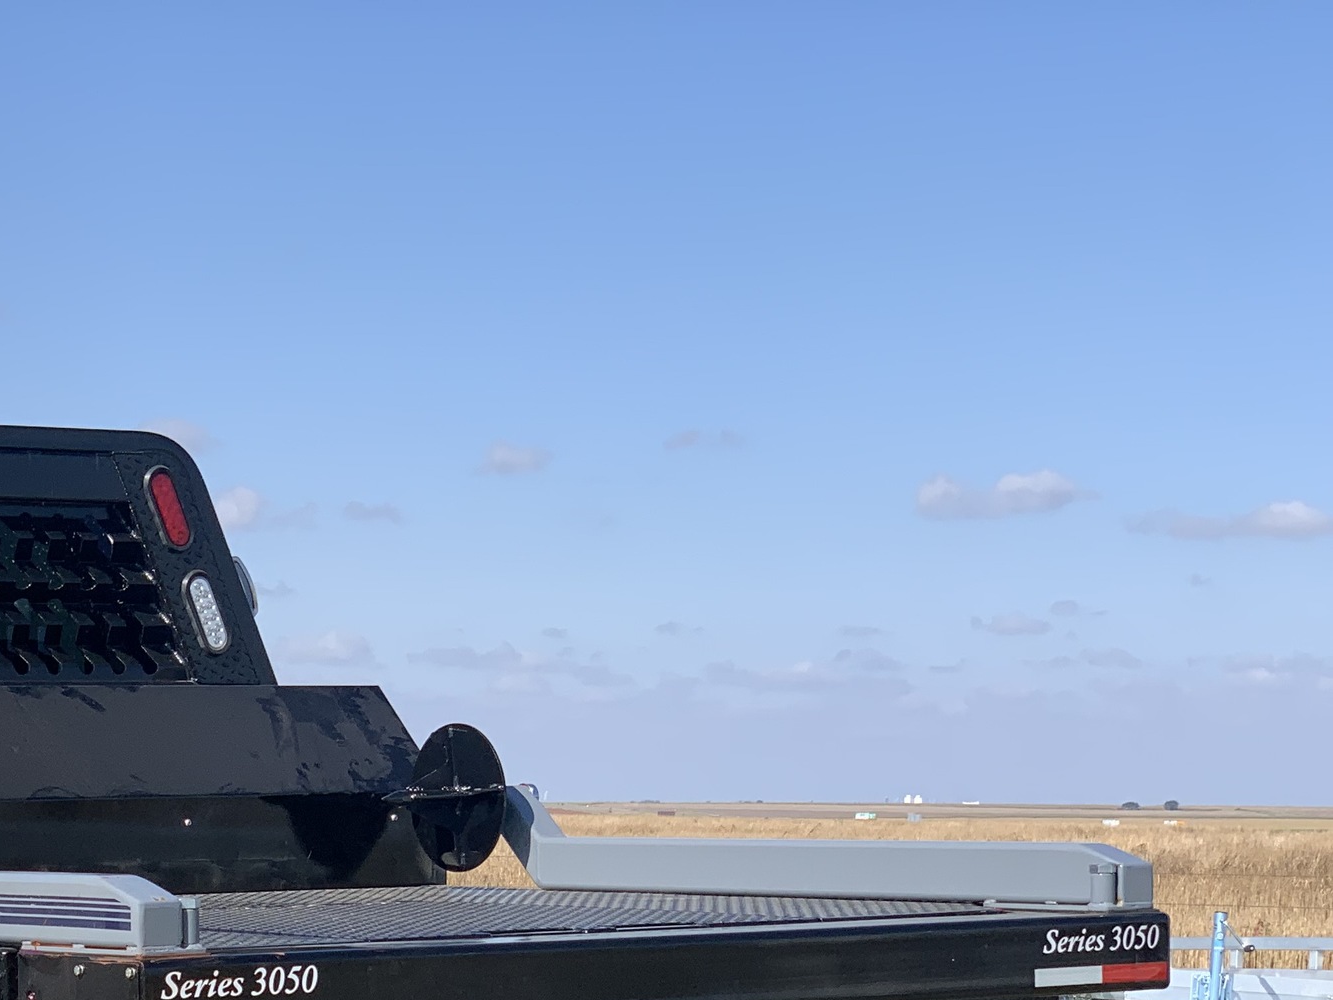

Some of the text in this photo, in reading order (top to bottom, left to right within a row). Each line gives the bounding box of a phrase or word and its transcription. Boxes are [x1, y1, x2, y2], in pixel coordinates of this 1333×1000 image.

[1043, 924, 1160, 954] Series 3050
[161, 964, 319, 1000] Series 3050
